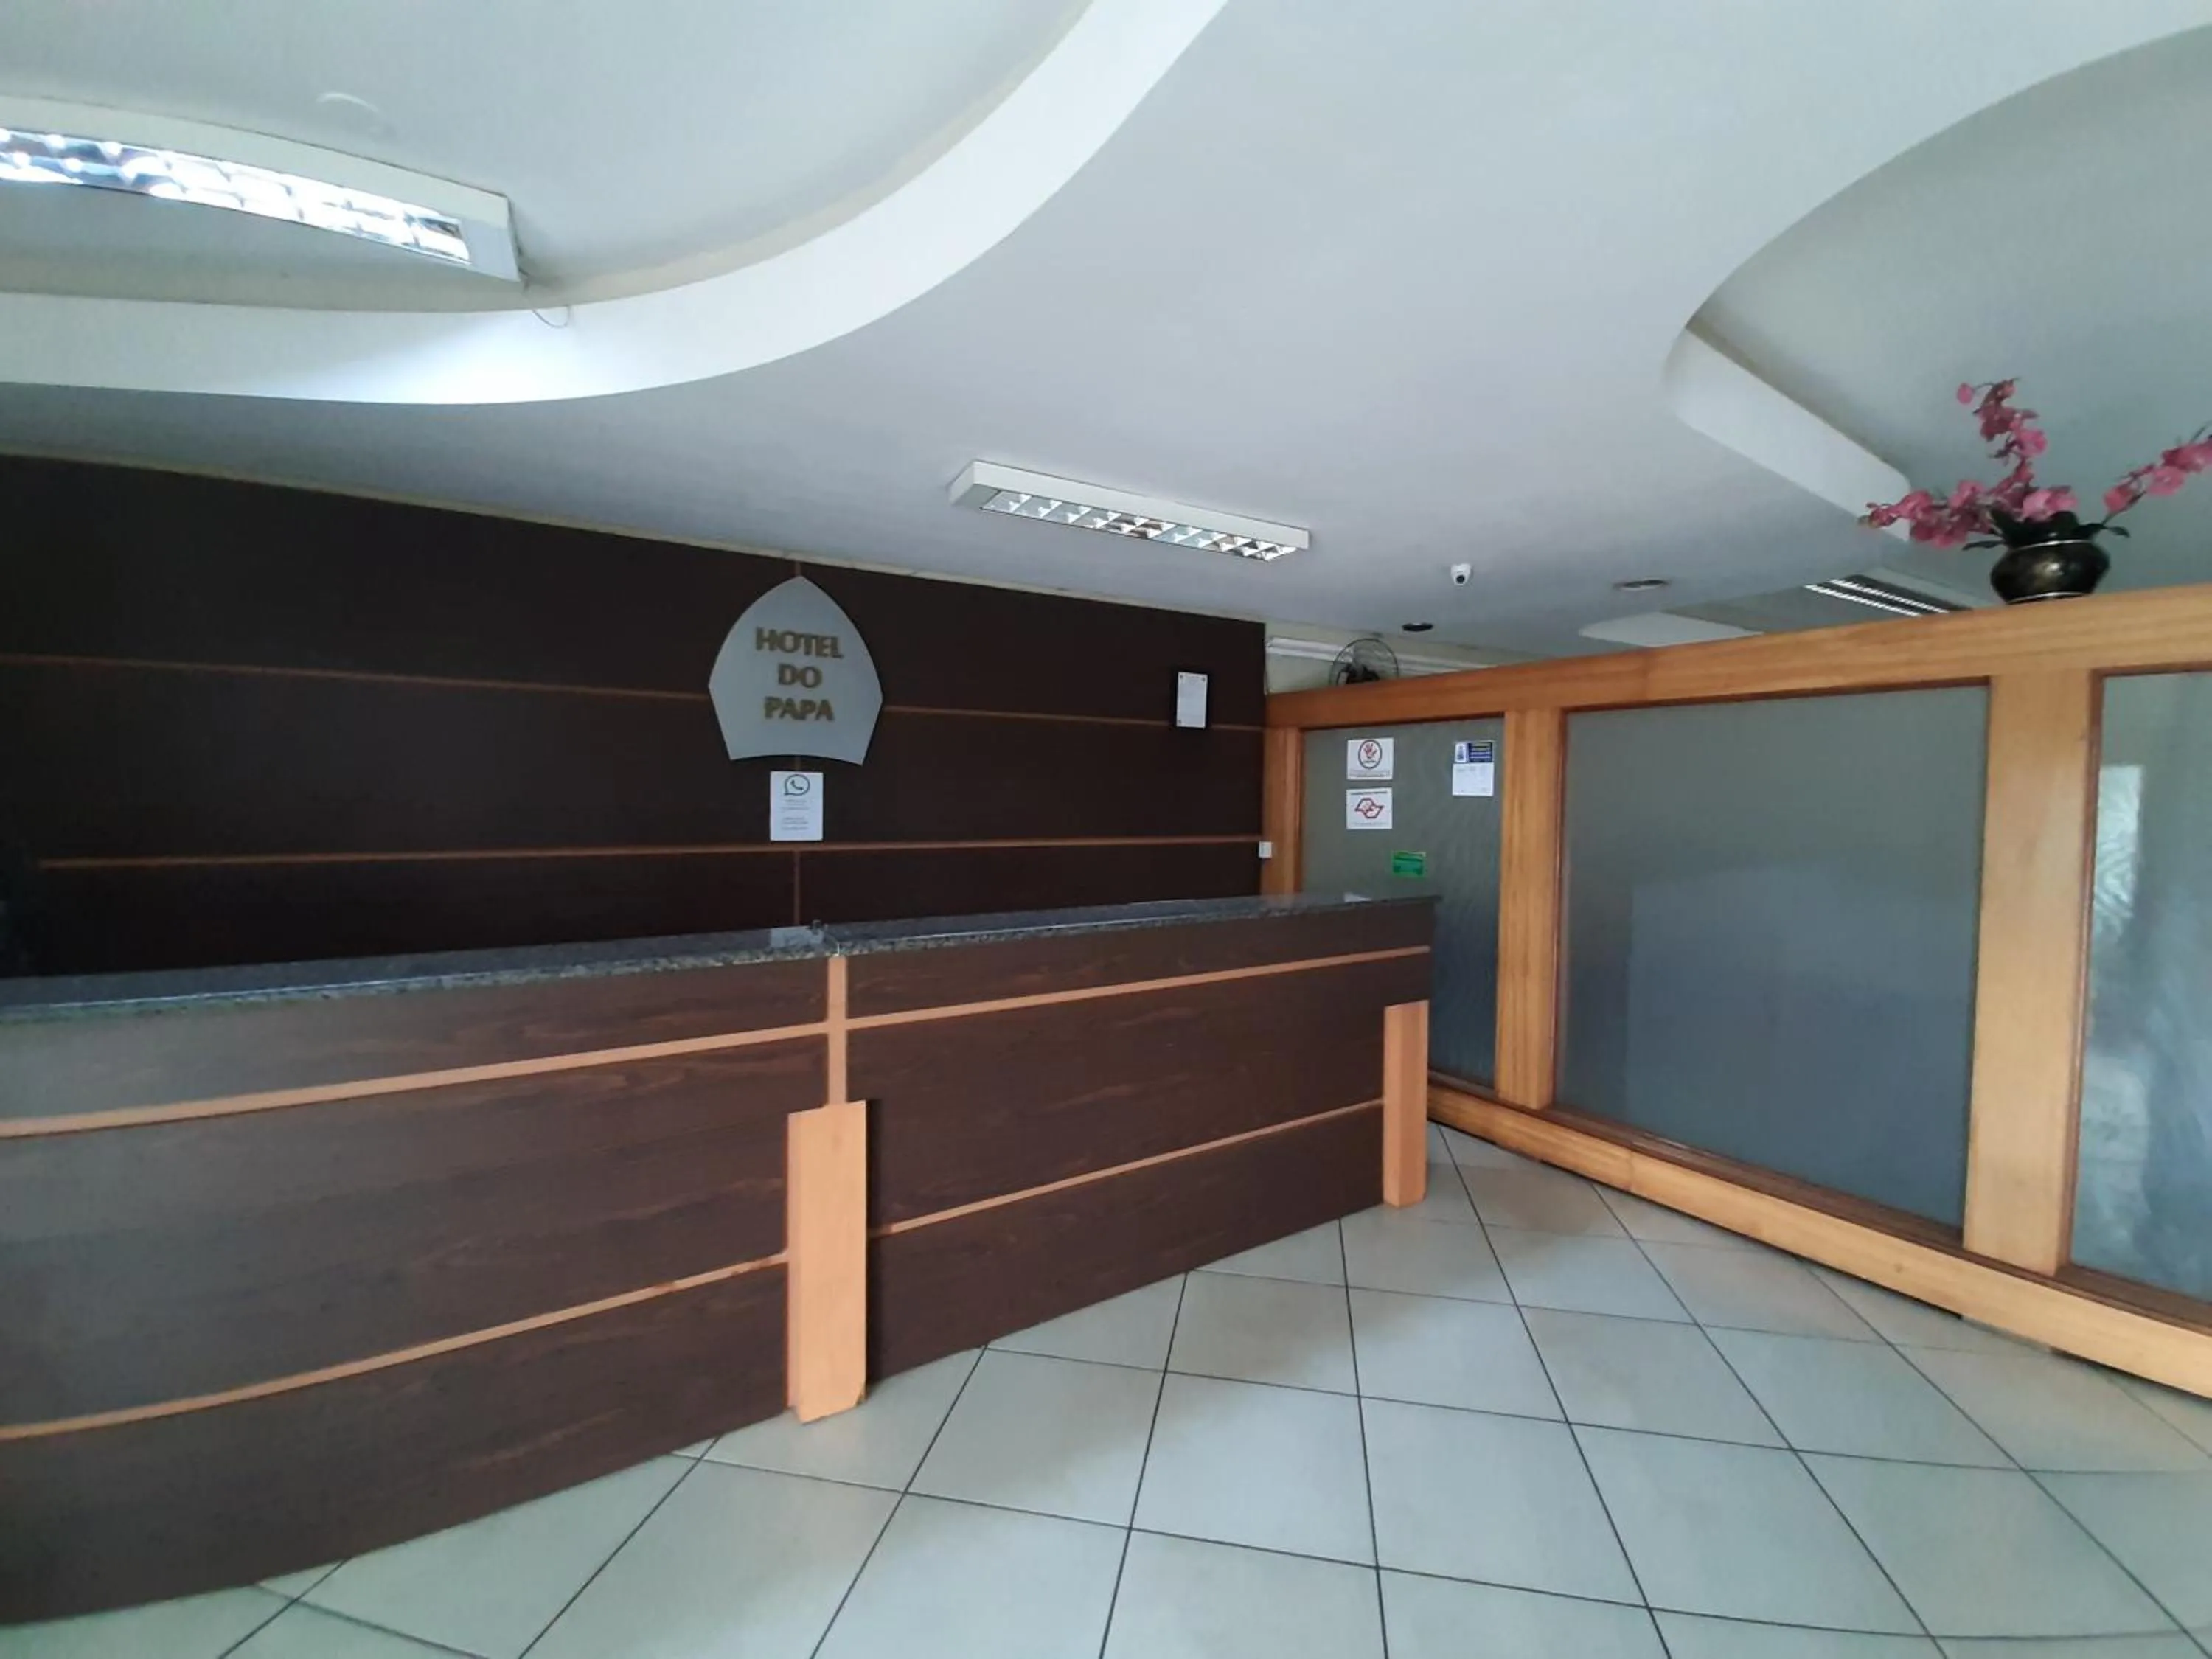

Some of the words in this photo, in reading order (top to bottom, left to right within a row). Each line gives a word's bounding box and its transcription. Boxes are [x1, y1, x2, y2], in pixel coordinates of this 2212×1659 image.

[756, 627, 844, 659] HOTEL
[778, 663, 823, 689] DO
[764, 696, 835, 721] PAPA
